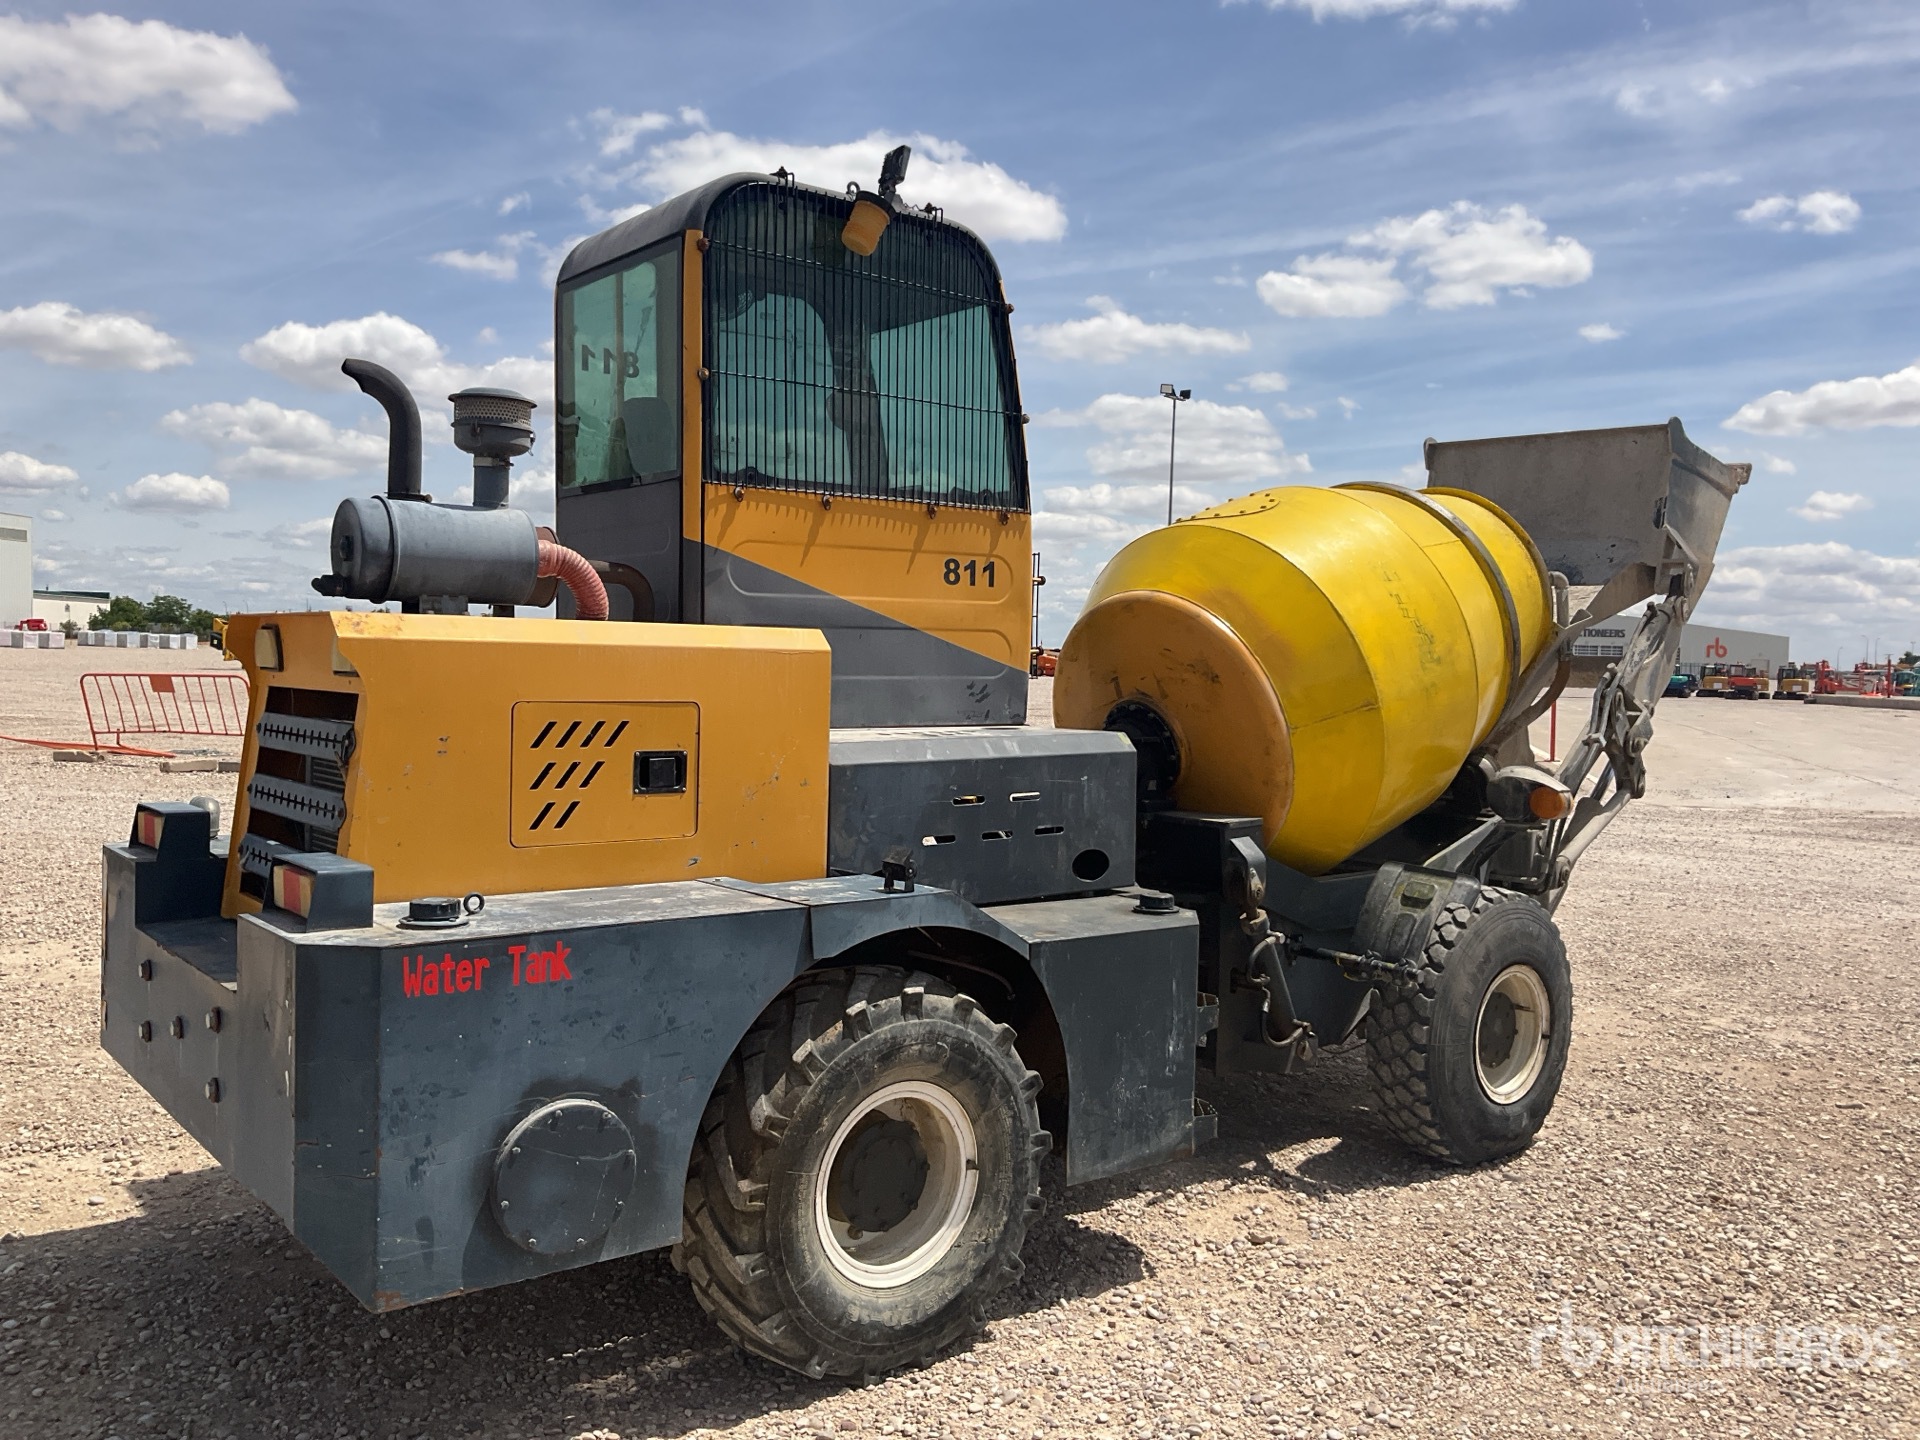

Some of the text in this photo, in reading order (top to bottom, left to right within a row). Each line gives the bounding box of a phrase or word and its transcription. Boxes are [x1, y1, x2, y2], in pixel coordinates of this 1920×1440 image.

[944, 558, 995, 588] 811
[1706, 636, 1728, 658] rb
[403, 940, 573, 998] Water Tank
